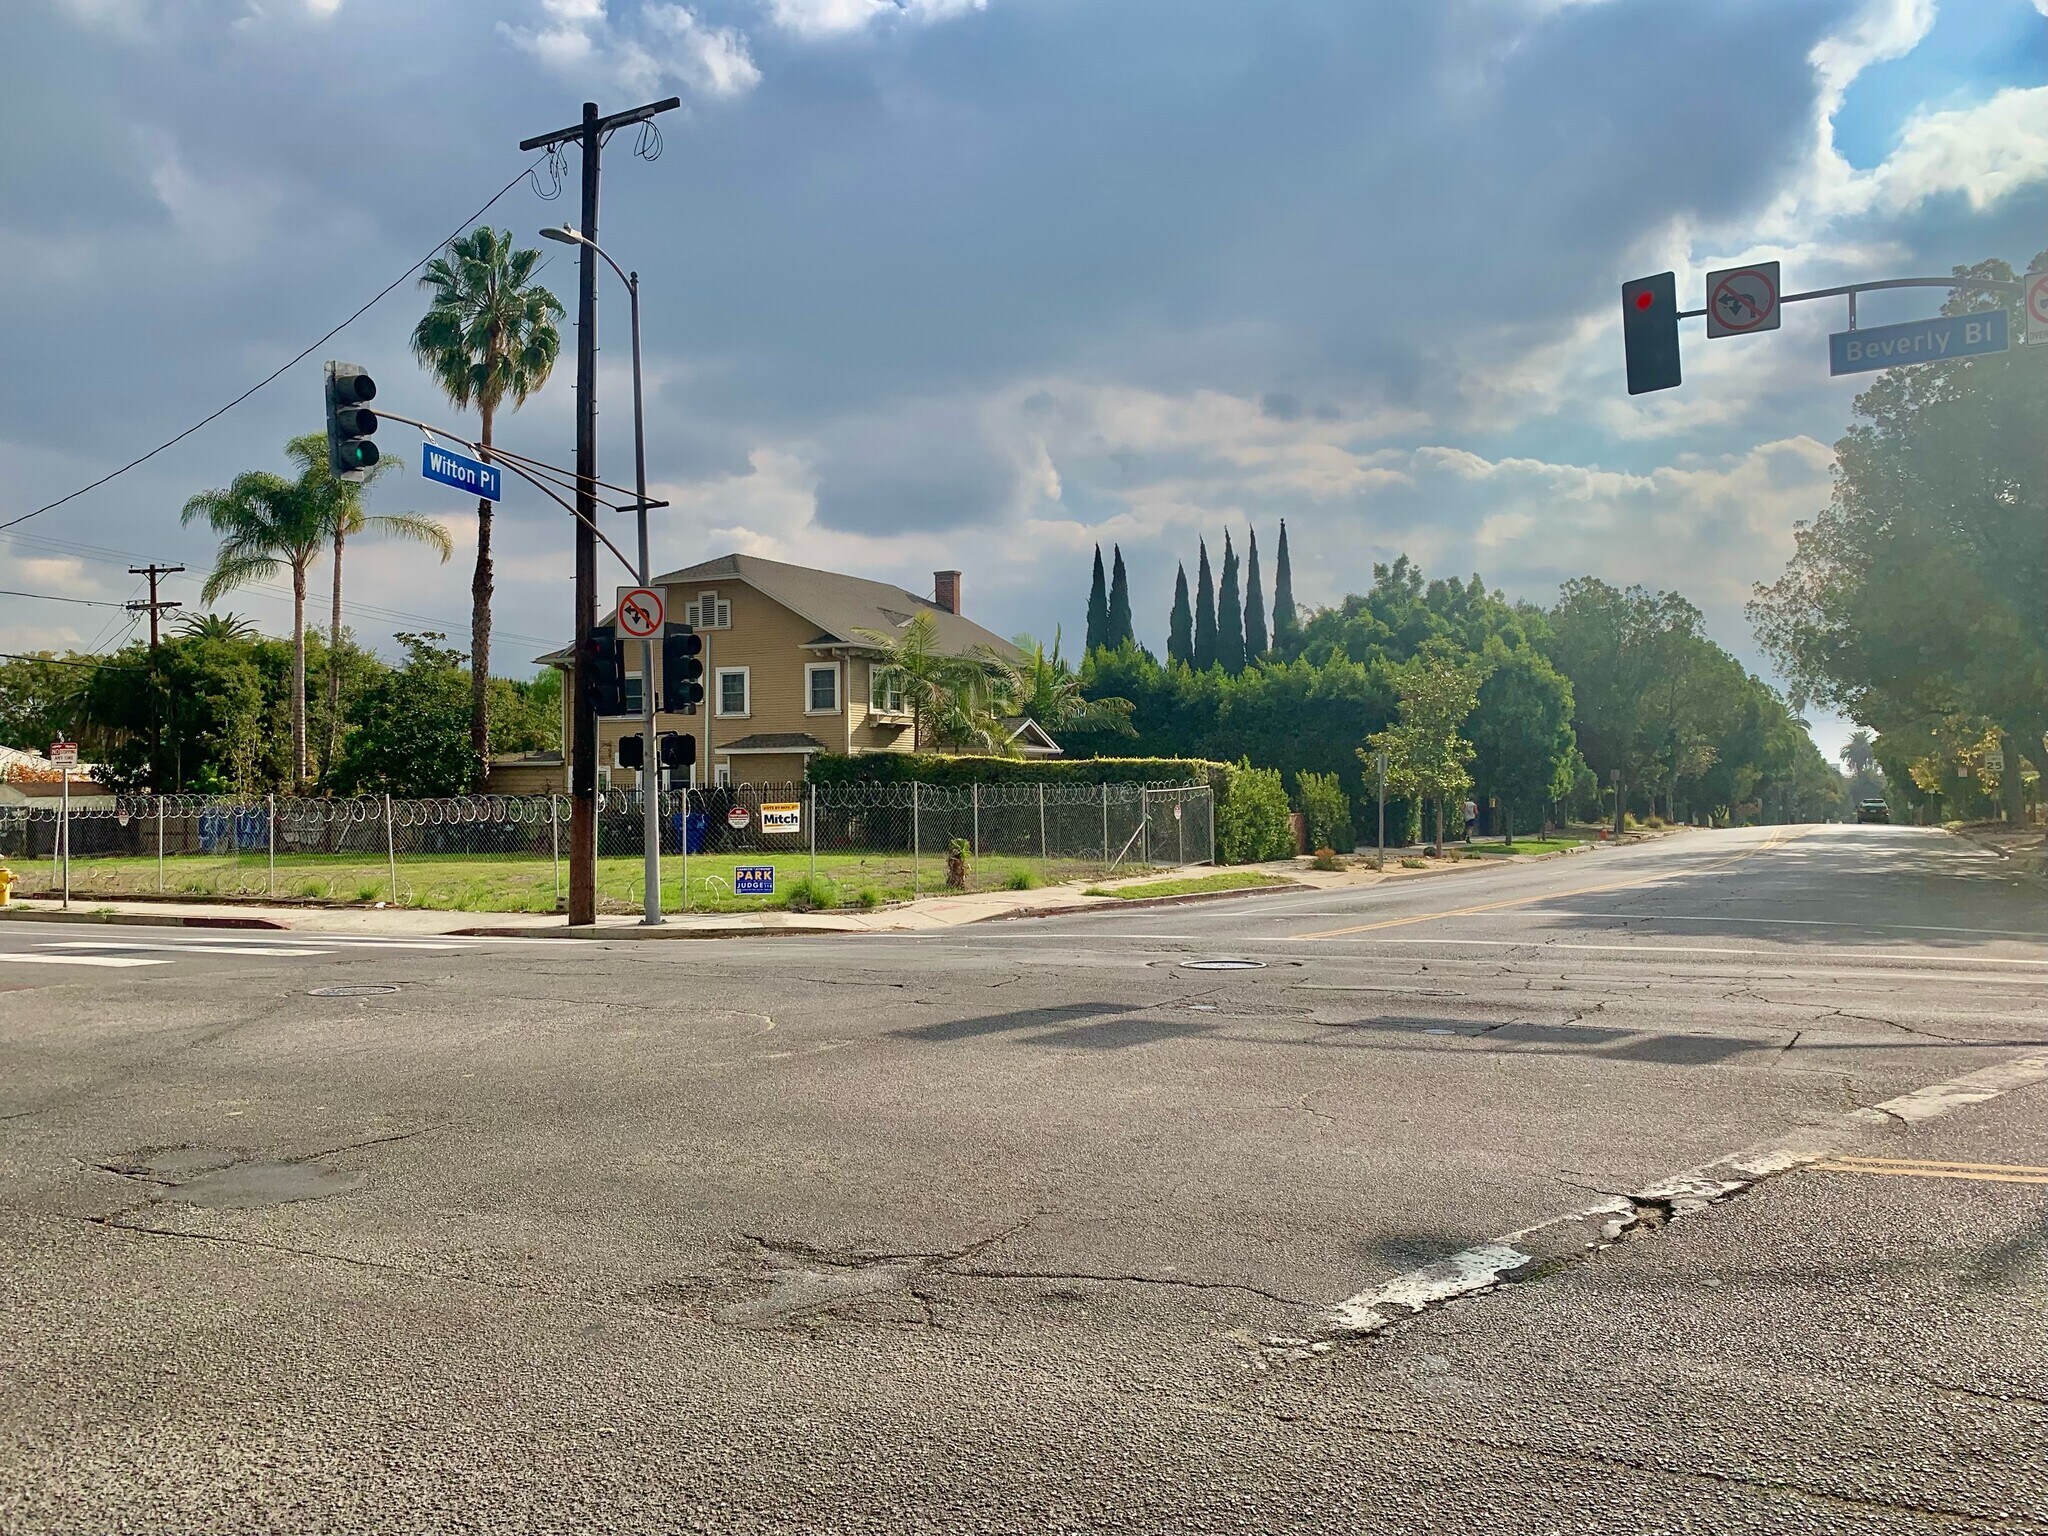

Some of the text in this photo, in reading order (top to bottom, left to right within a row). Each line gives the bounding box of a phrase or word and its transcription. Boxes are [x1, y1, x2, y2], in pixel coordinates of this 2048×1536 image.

[1846, 320, 1992, 361] Beverly Bl
[430, 452, 494, 491] Wilton Pl
[764, 813, 798, 824] Mitch
[737, 871, 772, 880] PARK
